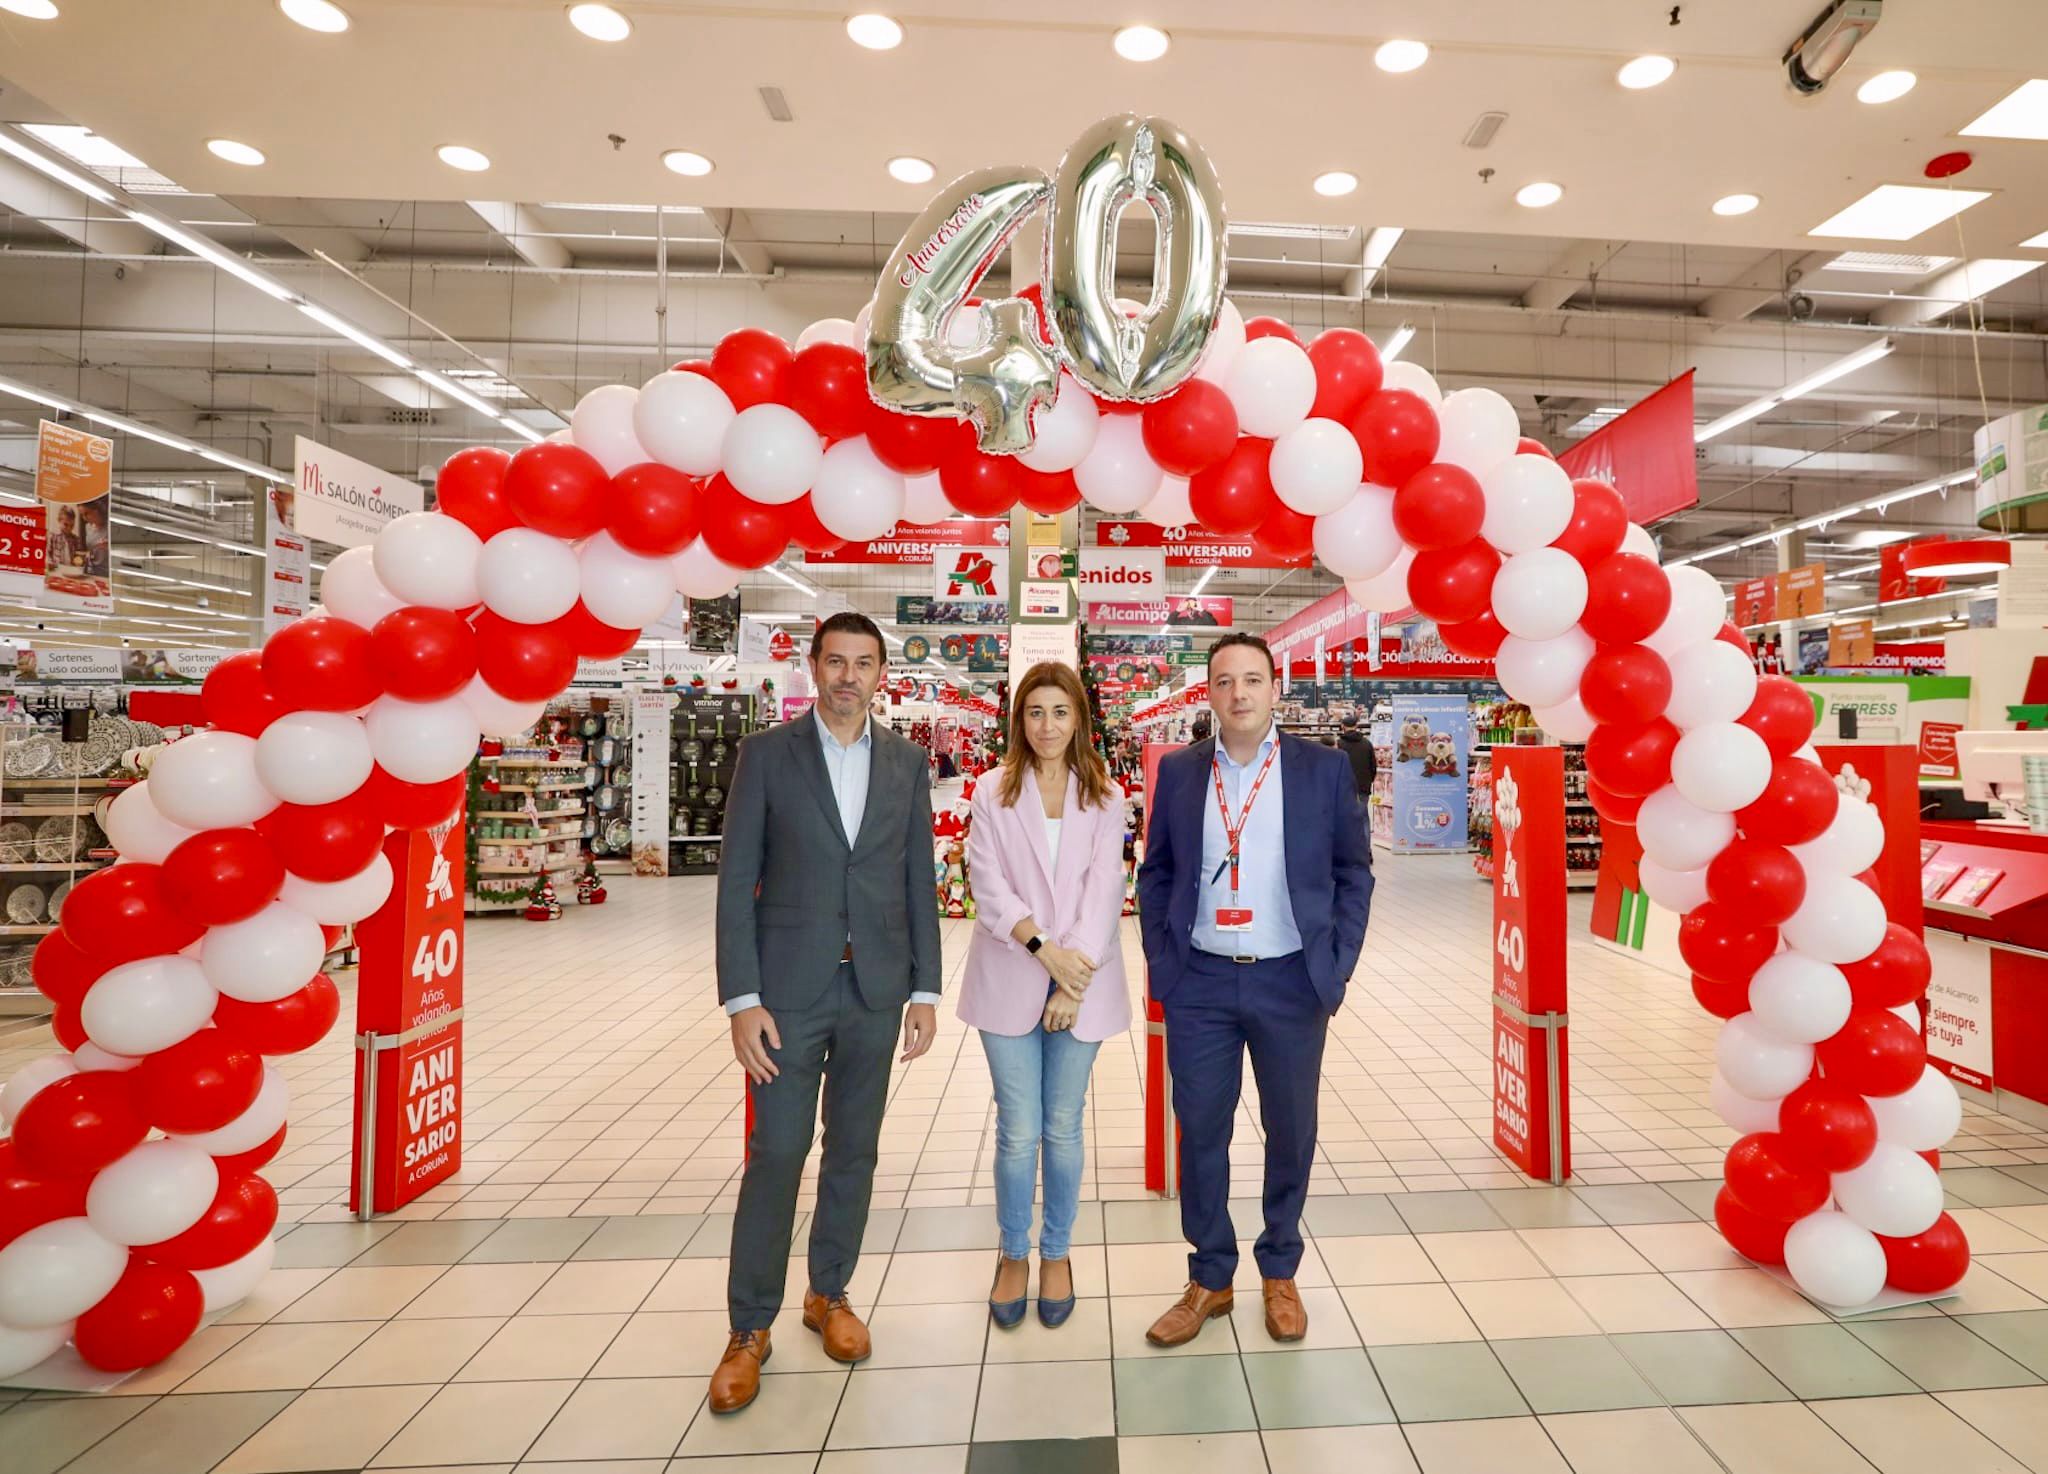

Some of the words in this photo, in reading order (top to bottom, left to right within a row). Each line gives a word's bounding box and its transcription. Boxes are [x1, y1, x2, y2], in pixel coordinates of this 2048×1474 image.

[303, 461, 324, 496] Mi
[327, 482, 366, 509] SALÓN
[1162, 526, 1187, 541] 40
[1096, 604, 1170, 624] Alcampo
[1140, 602, 1170, 610] Club
[49, 653, 93, 663] Sartenes
[49, 665, 68, 674] uso
[70, 664, 118, 674] ocasional
[178, 665, 197, 673] uso
[577, 667, 617, 676] ntensivo
[1829, 703, 1897, 715] EXPRESS
[412, 928, 458, 984] 40
[1497, 919, 1524, 973] 40
[420, 988, 445, 1008] Años
[1945, 986, 1980, 1004] Alcampo
[412, 1001, 452, 1027] volando
[1934, 1007, 1979, 1035] siempre,
[1940, 1027, 1963, 1047] tuya
[1498, 1030, 1525, 1075] ANI
[408, 1045, 454, 1098] ANI
[1497, 1061, 1528, 1113] VER
[405, 1083, 457, 1135] VER
[1496, 1098, 1528, 1140] SARIO
[404, 1120, 456, 1168] SARIO
[408, 1172, 415, 1185] A
[415, 1152, 449, 1179] CORUÑA
